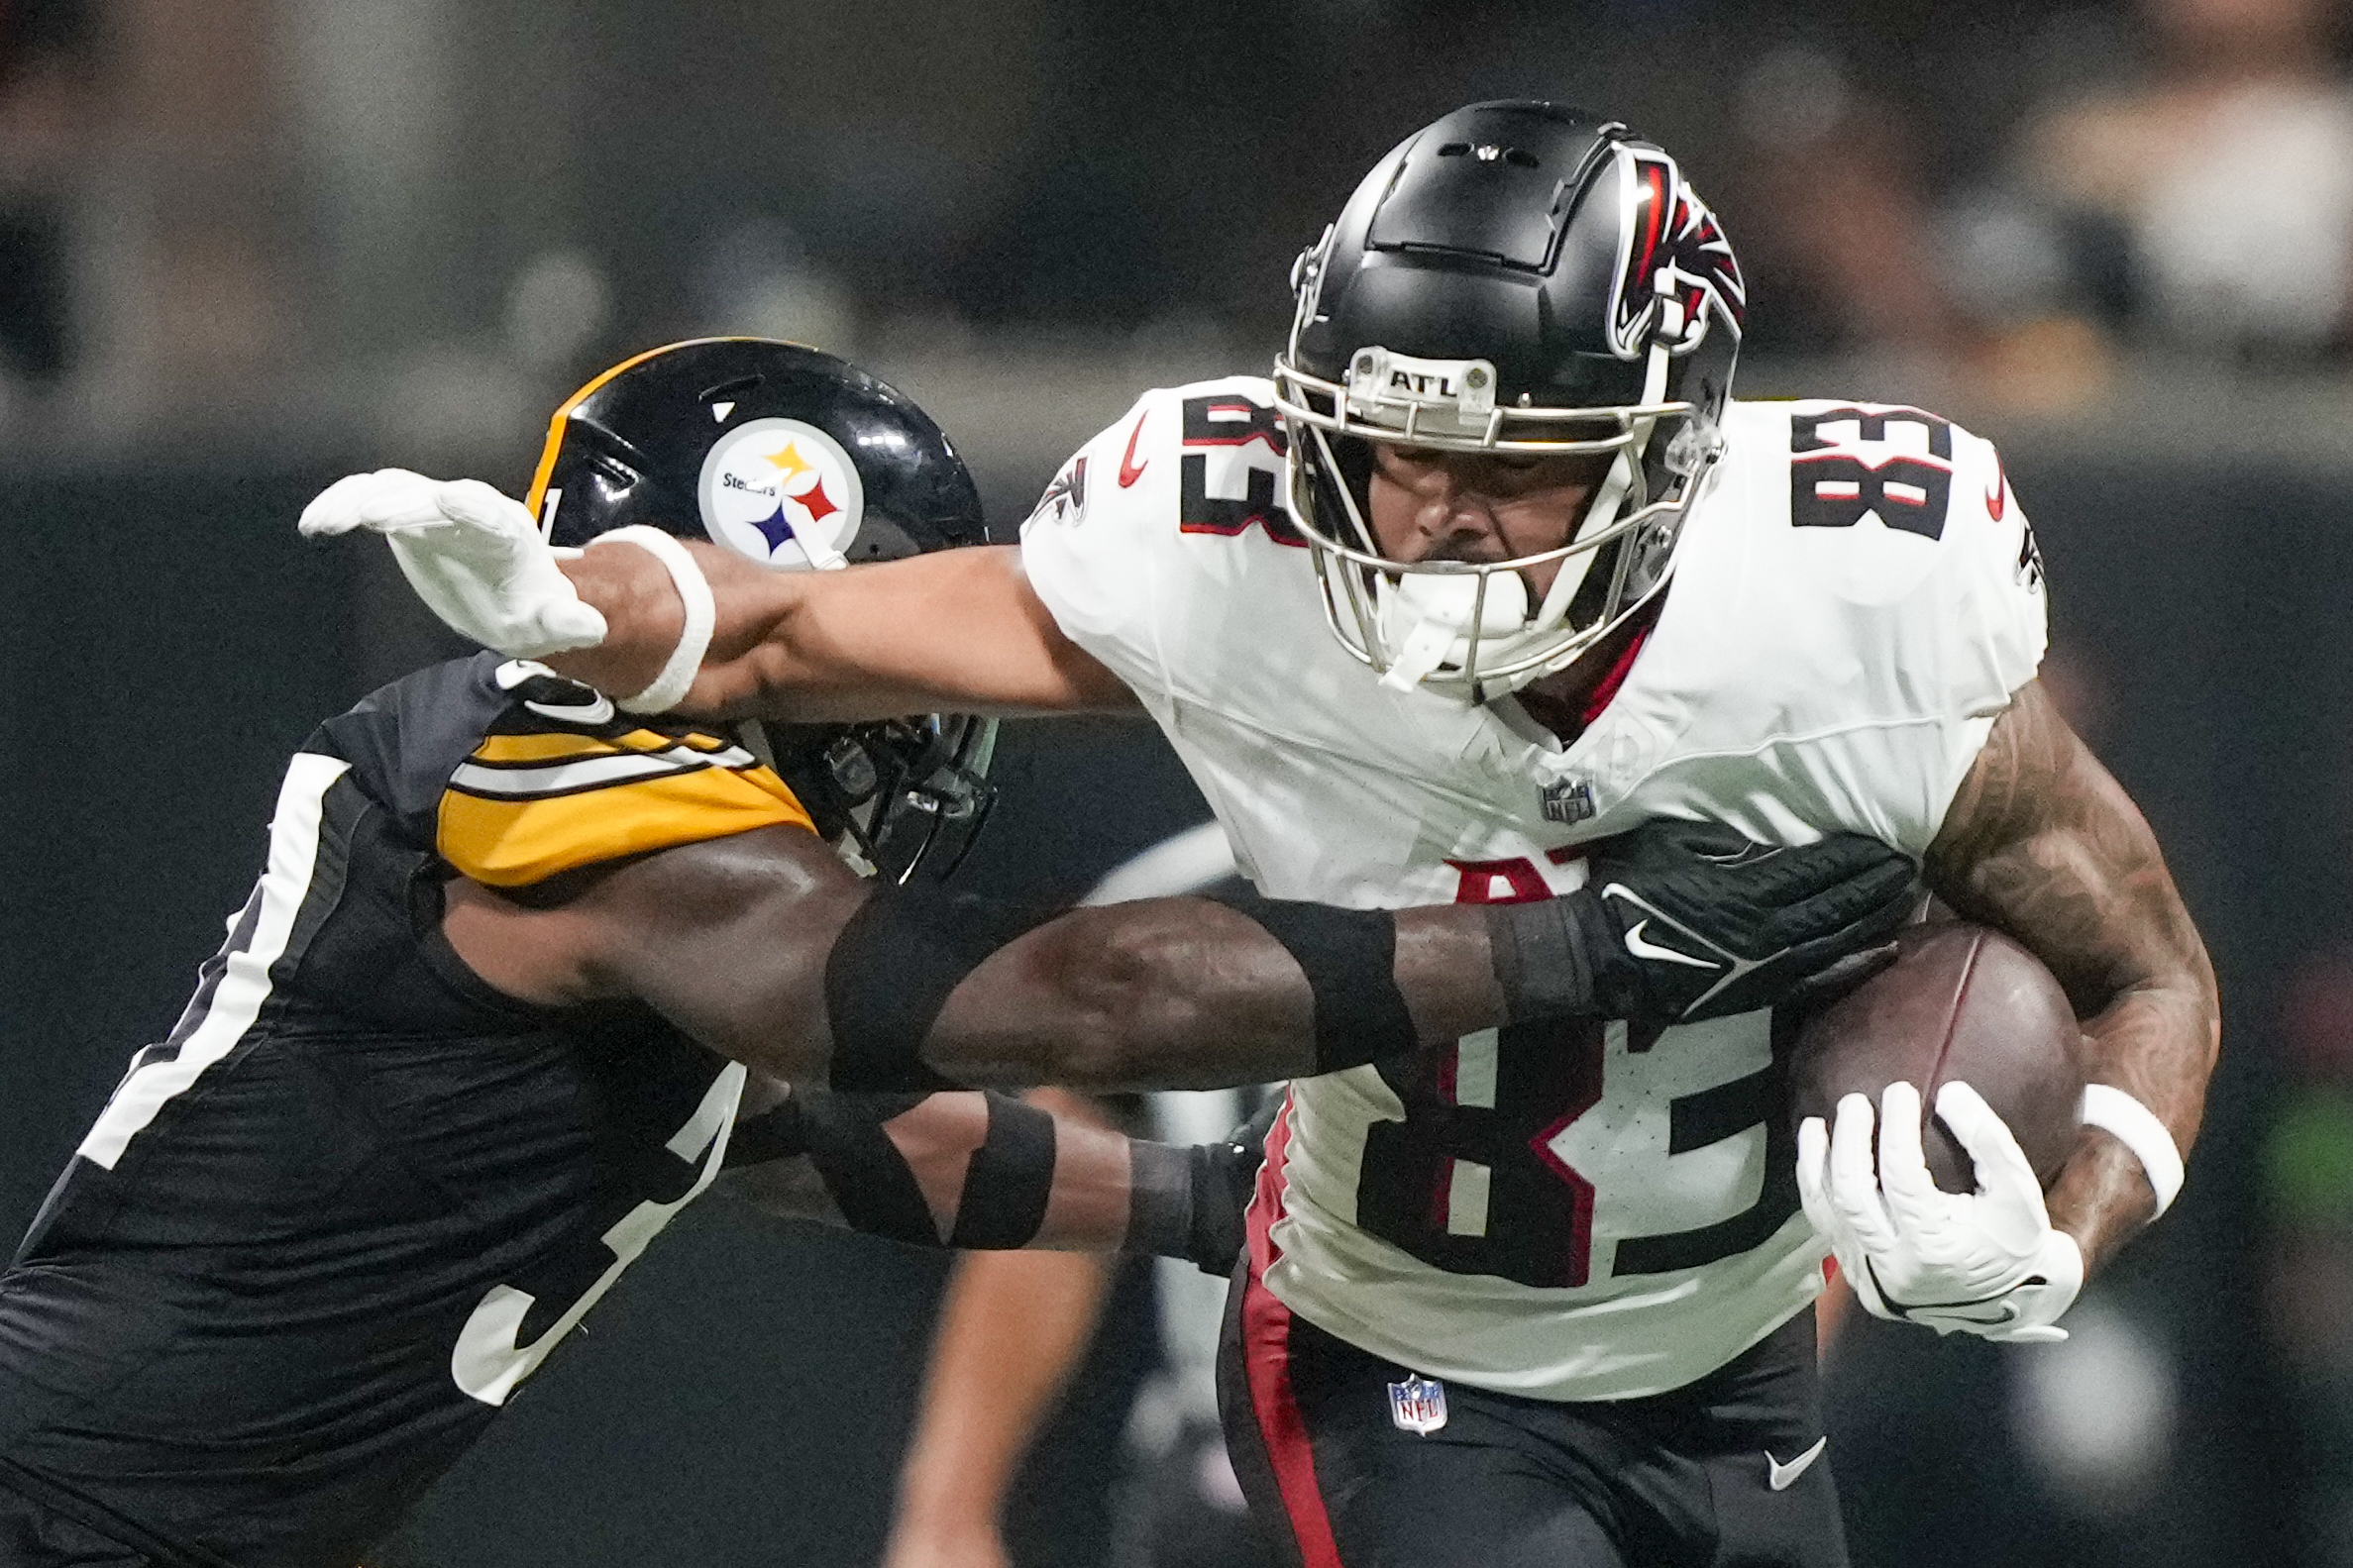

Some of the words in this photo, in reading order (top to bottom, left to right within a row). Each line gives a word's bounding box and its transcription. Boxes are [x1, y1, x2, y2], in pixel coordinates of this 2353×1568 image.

[1390, 368, 1458, 397] ATL
[1790, 407, 1953, 542] 83
[1400, 1398, 1439, 1422] NFL
